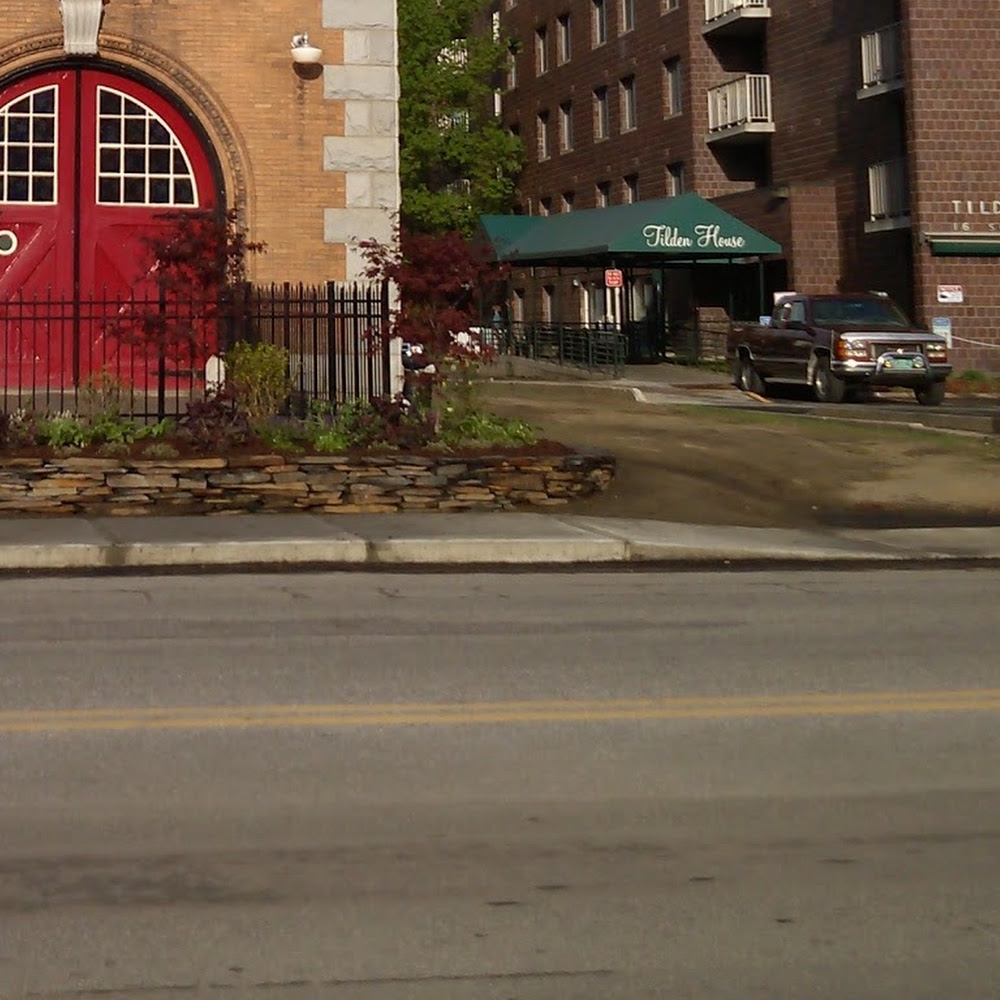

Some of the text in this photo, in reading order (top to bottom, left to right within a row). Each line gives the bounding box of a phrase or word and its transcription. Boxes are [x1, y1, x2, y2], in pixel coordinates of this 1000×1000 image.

[953, 222, 970, 231] 16
[642, 224, 746, 248] Tilden House
